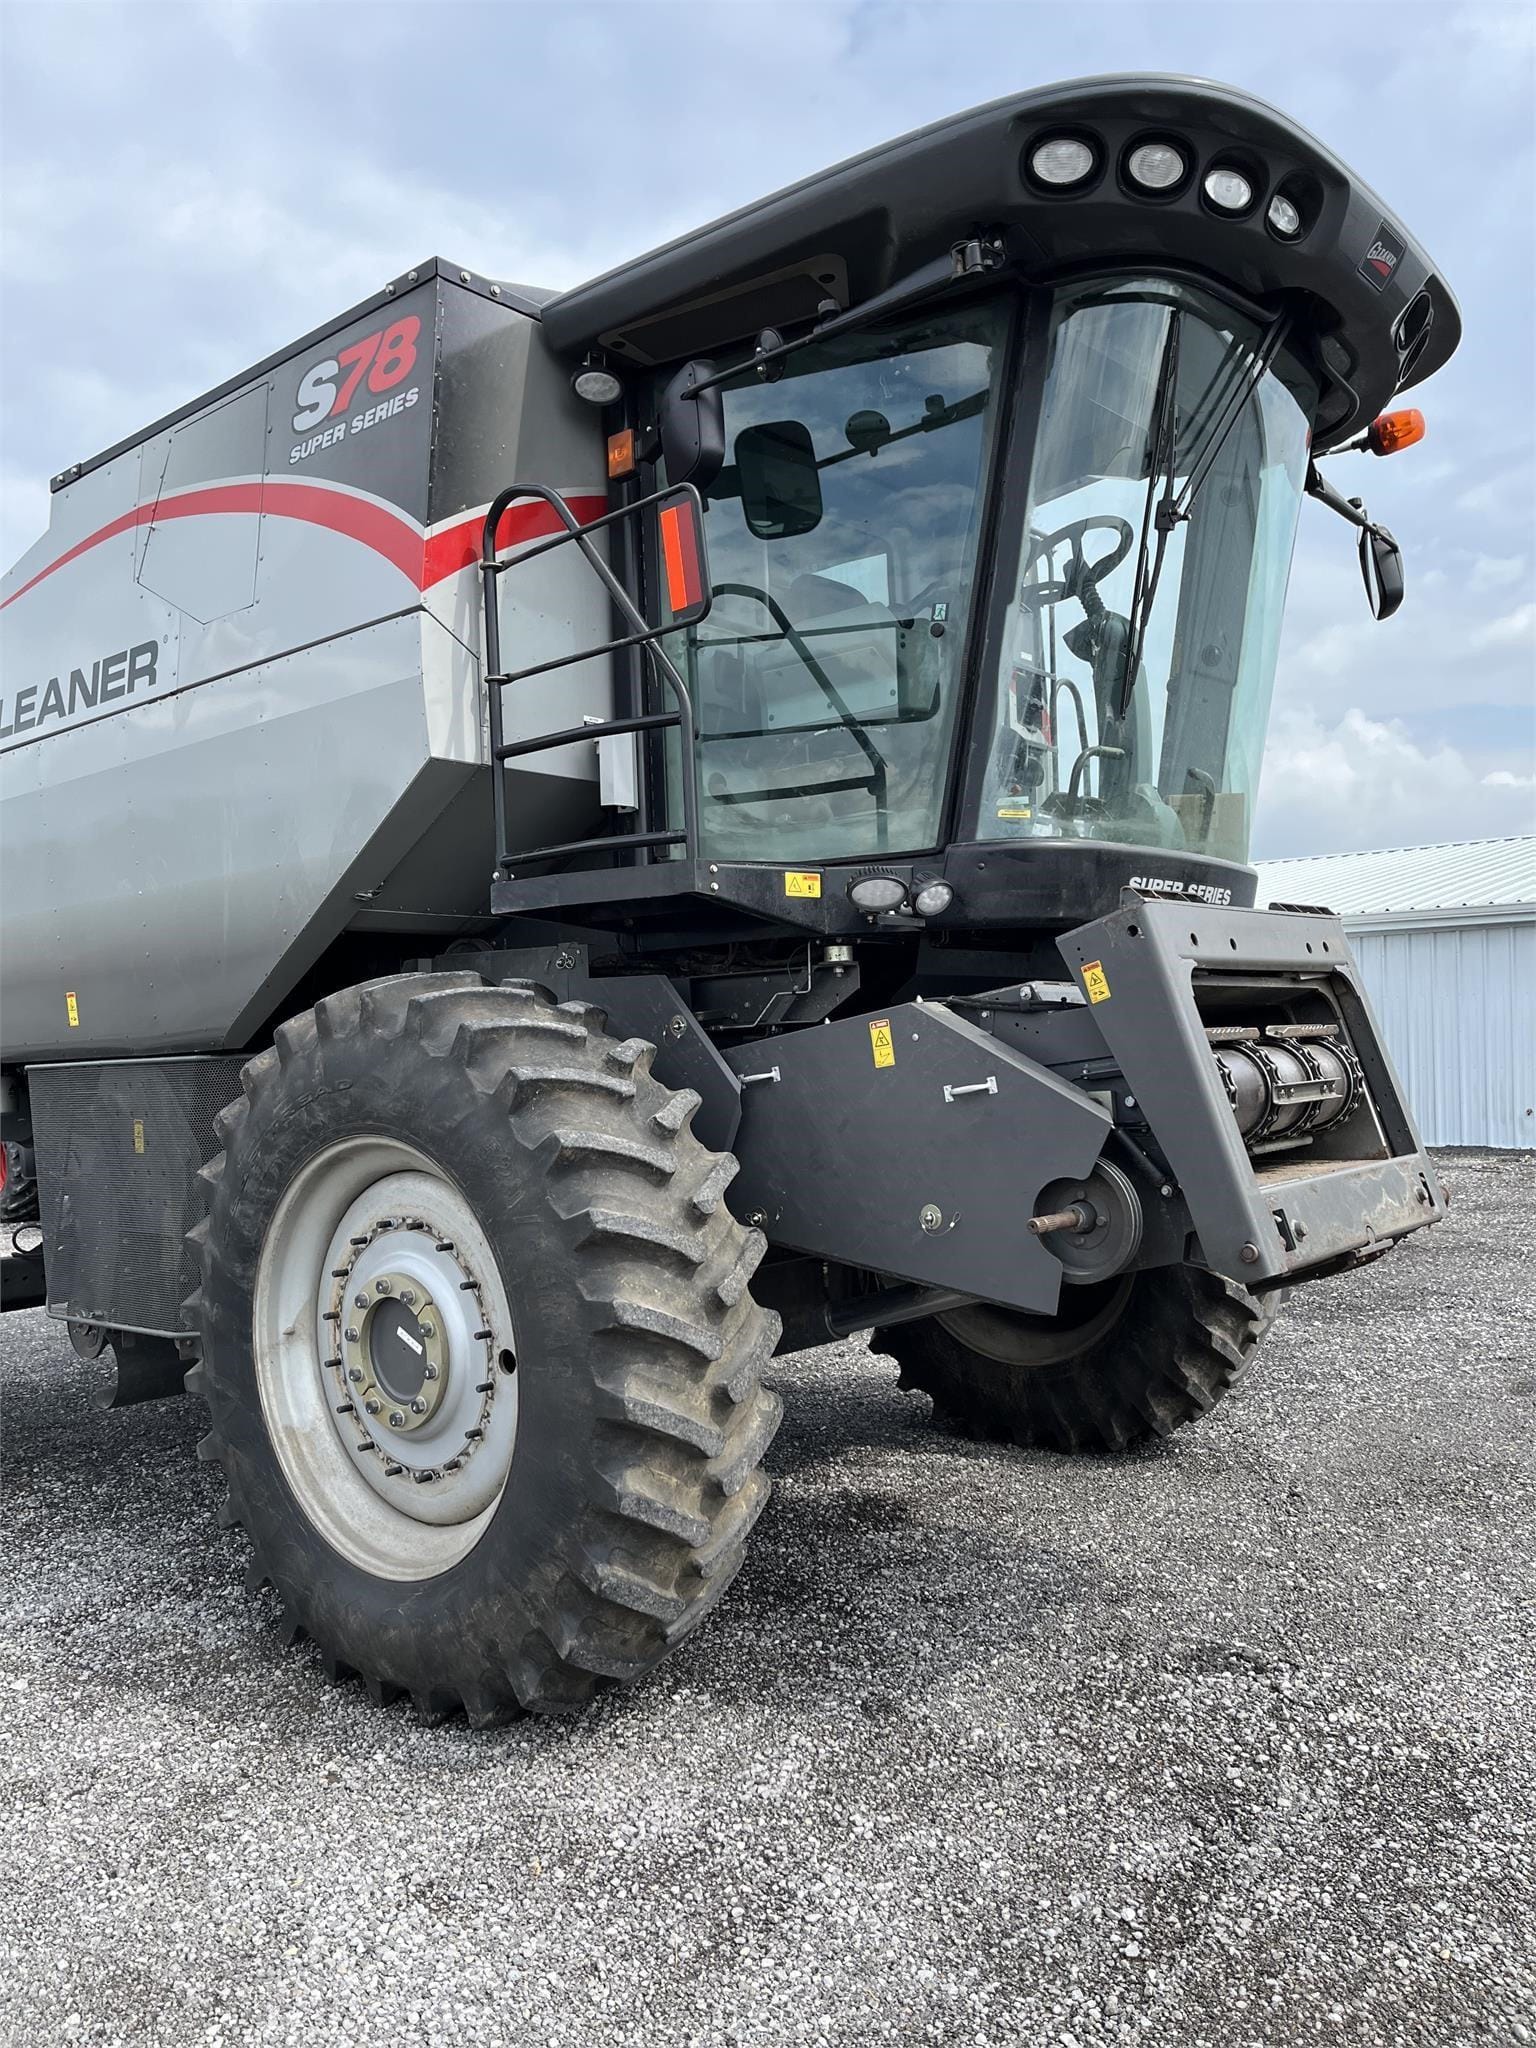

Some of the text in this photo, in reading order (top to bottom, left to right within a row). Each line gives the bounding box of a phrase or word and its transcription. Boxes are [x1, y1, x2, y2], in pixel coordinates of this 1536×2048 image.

[292, 314, 421, 432] S78
[288, 387, 420, 465] SUPER SERIES
